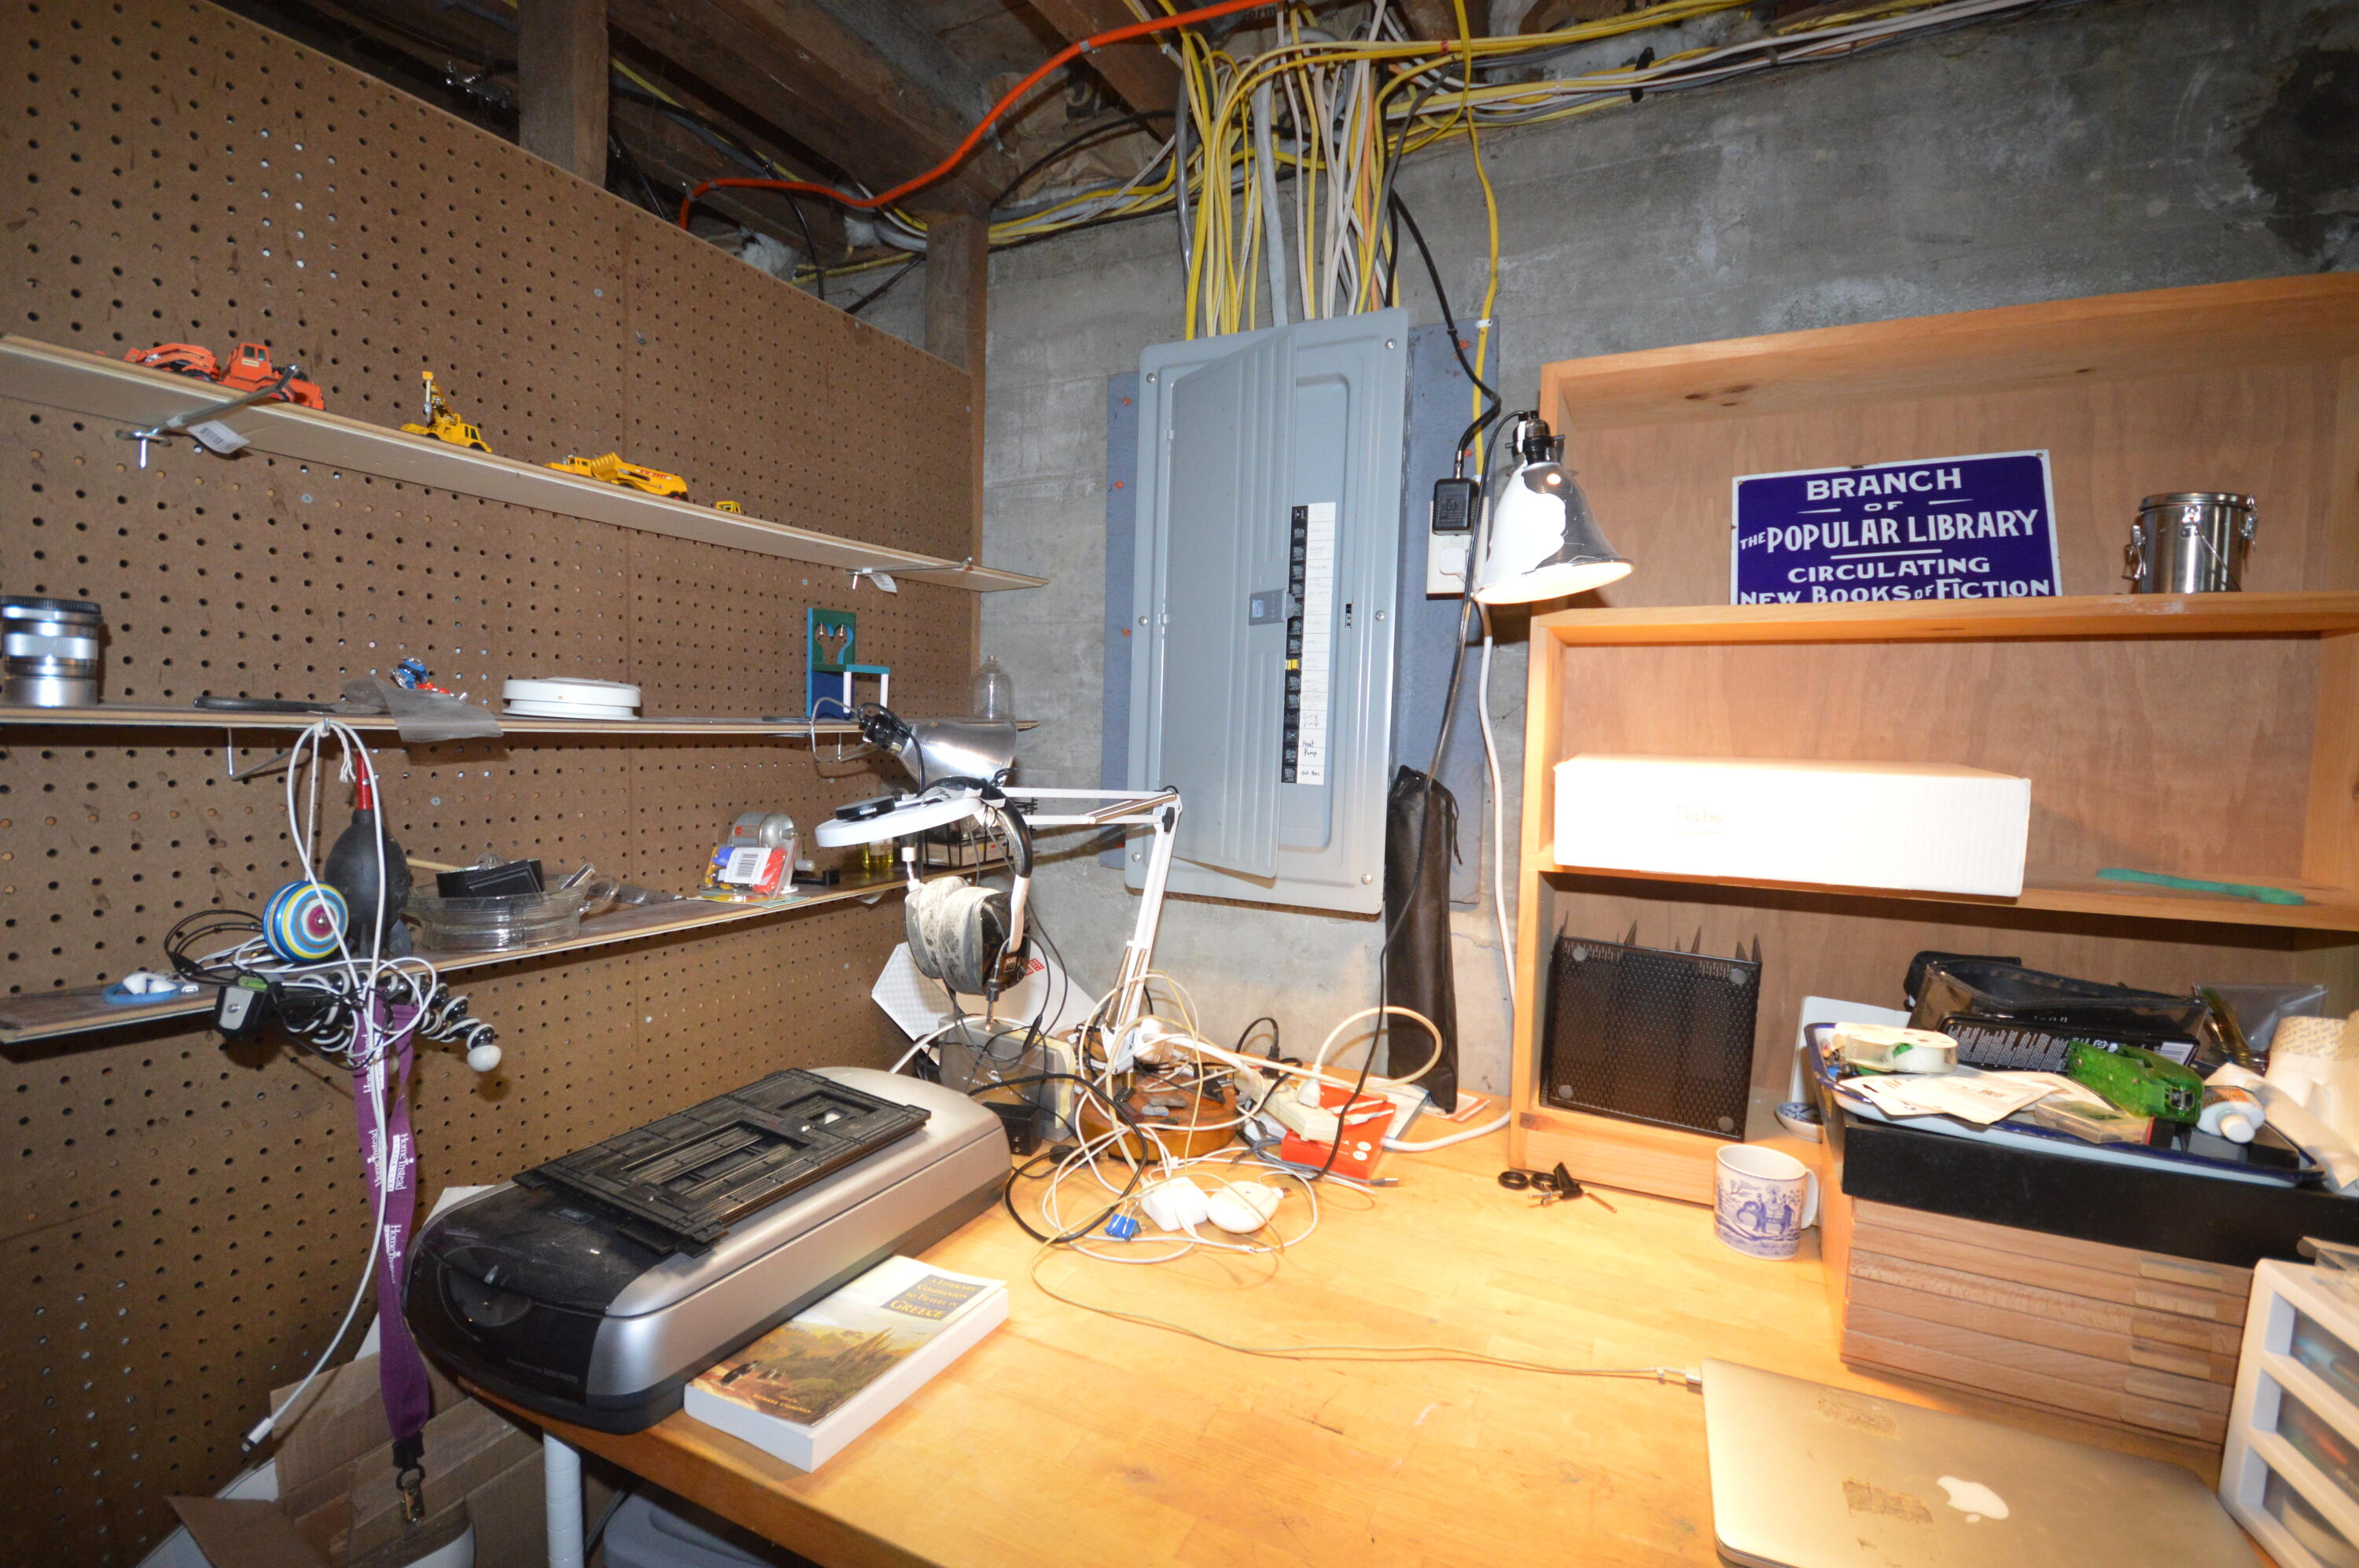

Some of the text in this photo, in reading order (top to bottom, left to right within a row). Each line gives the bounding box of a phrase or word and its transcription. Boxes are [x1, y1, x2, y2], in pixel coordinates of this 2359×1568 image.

[1806, 468, 1962, 501] BRANCH
[1864, 500, 1904, 512] OF
[1740, 509, 2039, 554] THE POPULAR LIBRARY
[1788, 557, 1990, 583] CIRCULATING
[1740, 578, 2049, 605] NEW BOOKS OF FICTION
[395, 1133, 414, 1191] Home Instead
[390, 1224, 402, 1250] Home
[890, 1300, 944, 1319] GREECE
